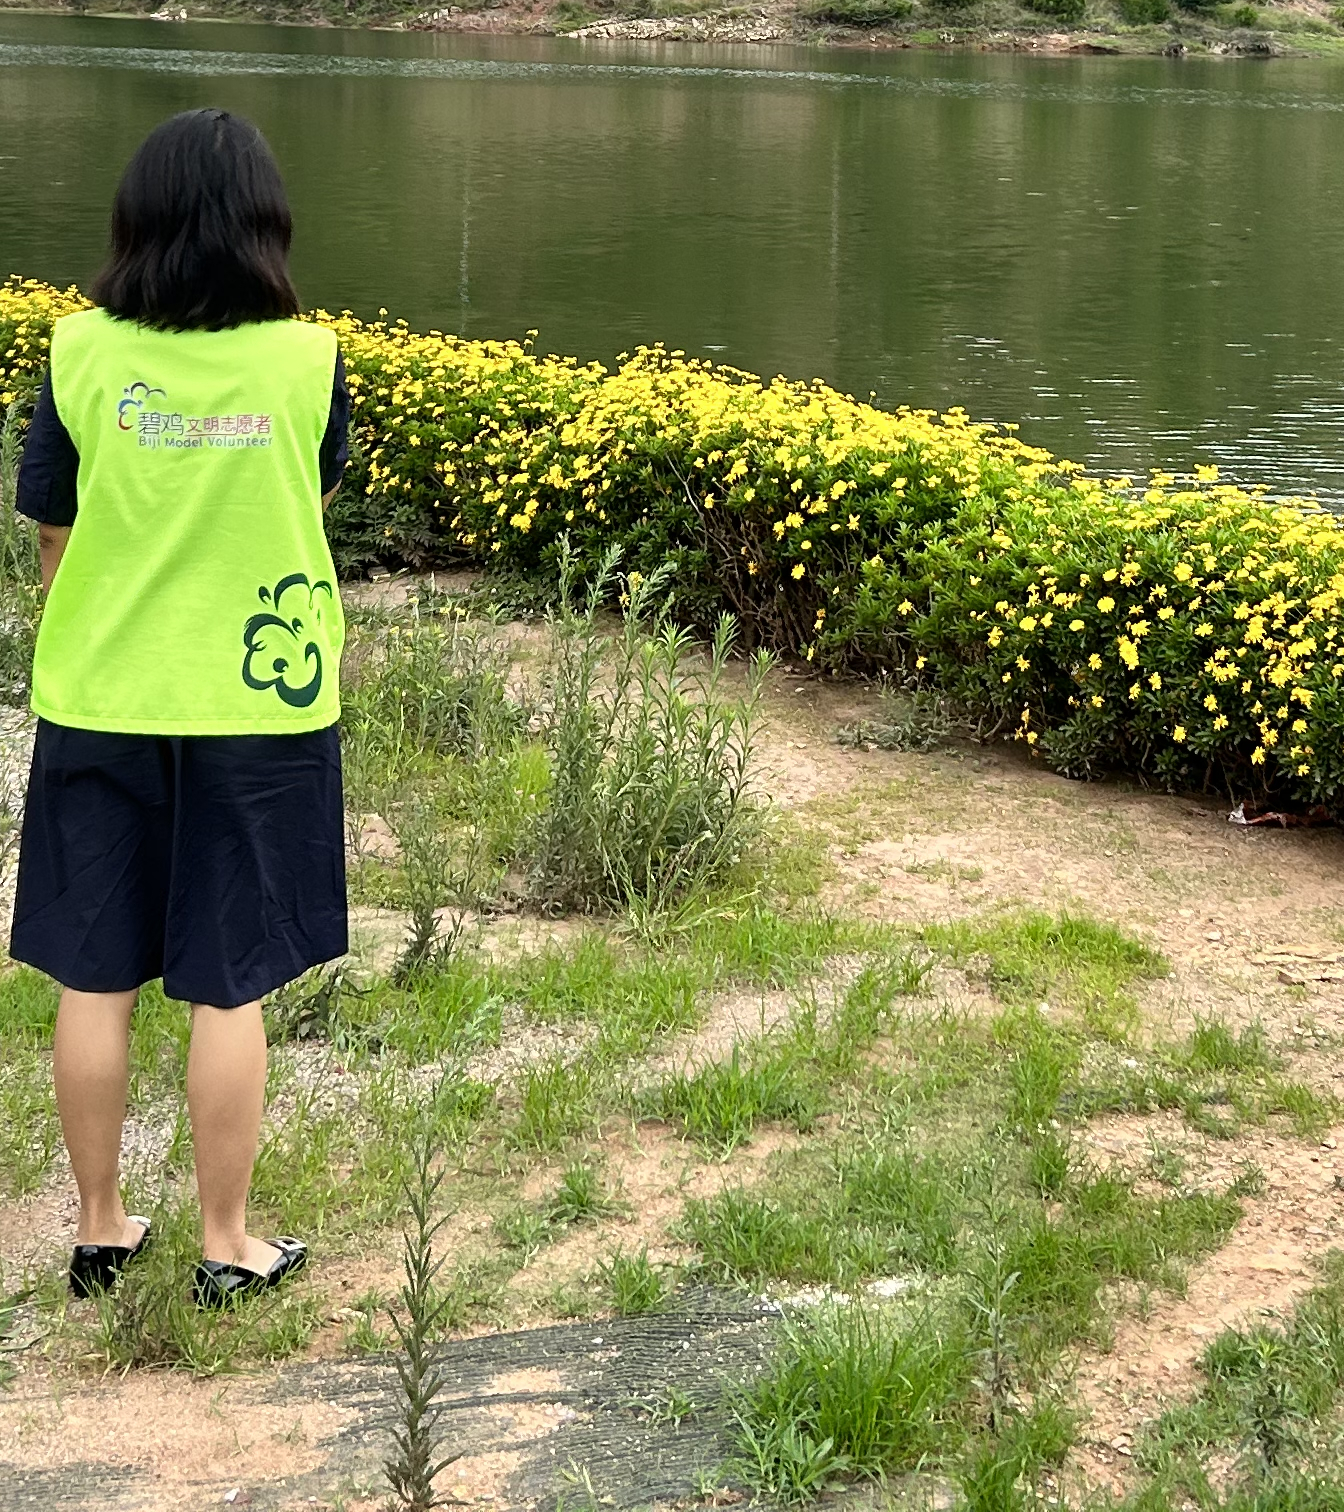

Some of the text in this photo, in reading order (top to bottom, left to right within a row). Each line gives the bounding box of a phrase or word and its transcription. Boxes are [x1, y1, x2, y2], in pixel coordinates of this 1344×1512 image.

[138, 436, 273, 449] Biji Model Volunteer
